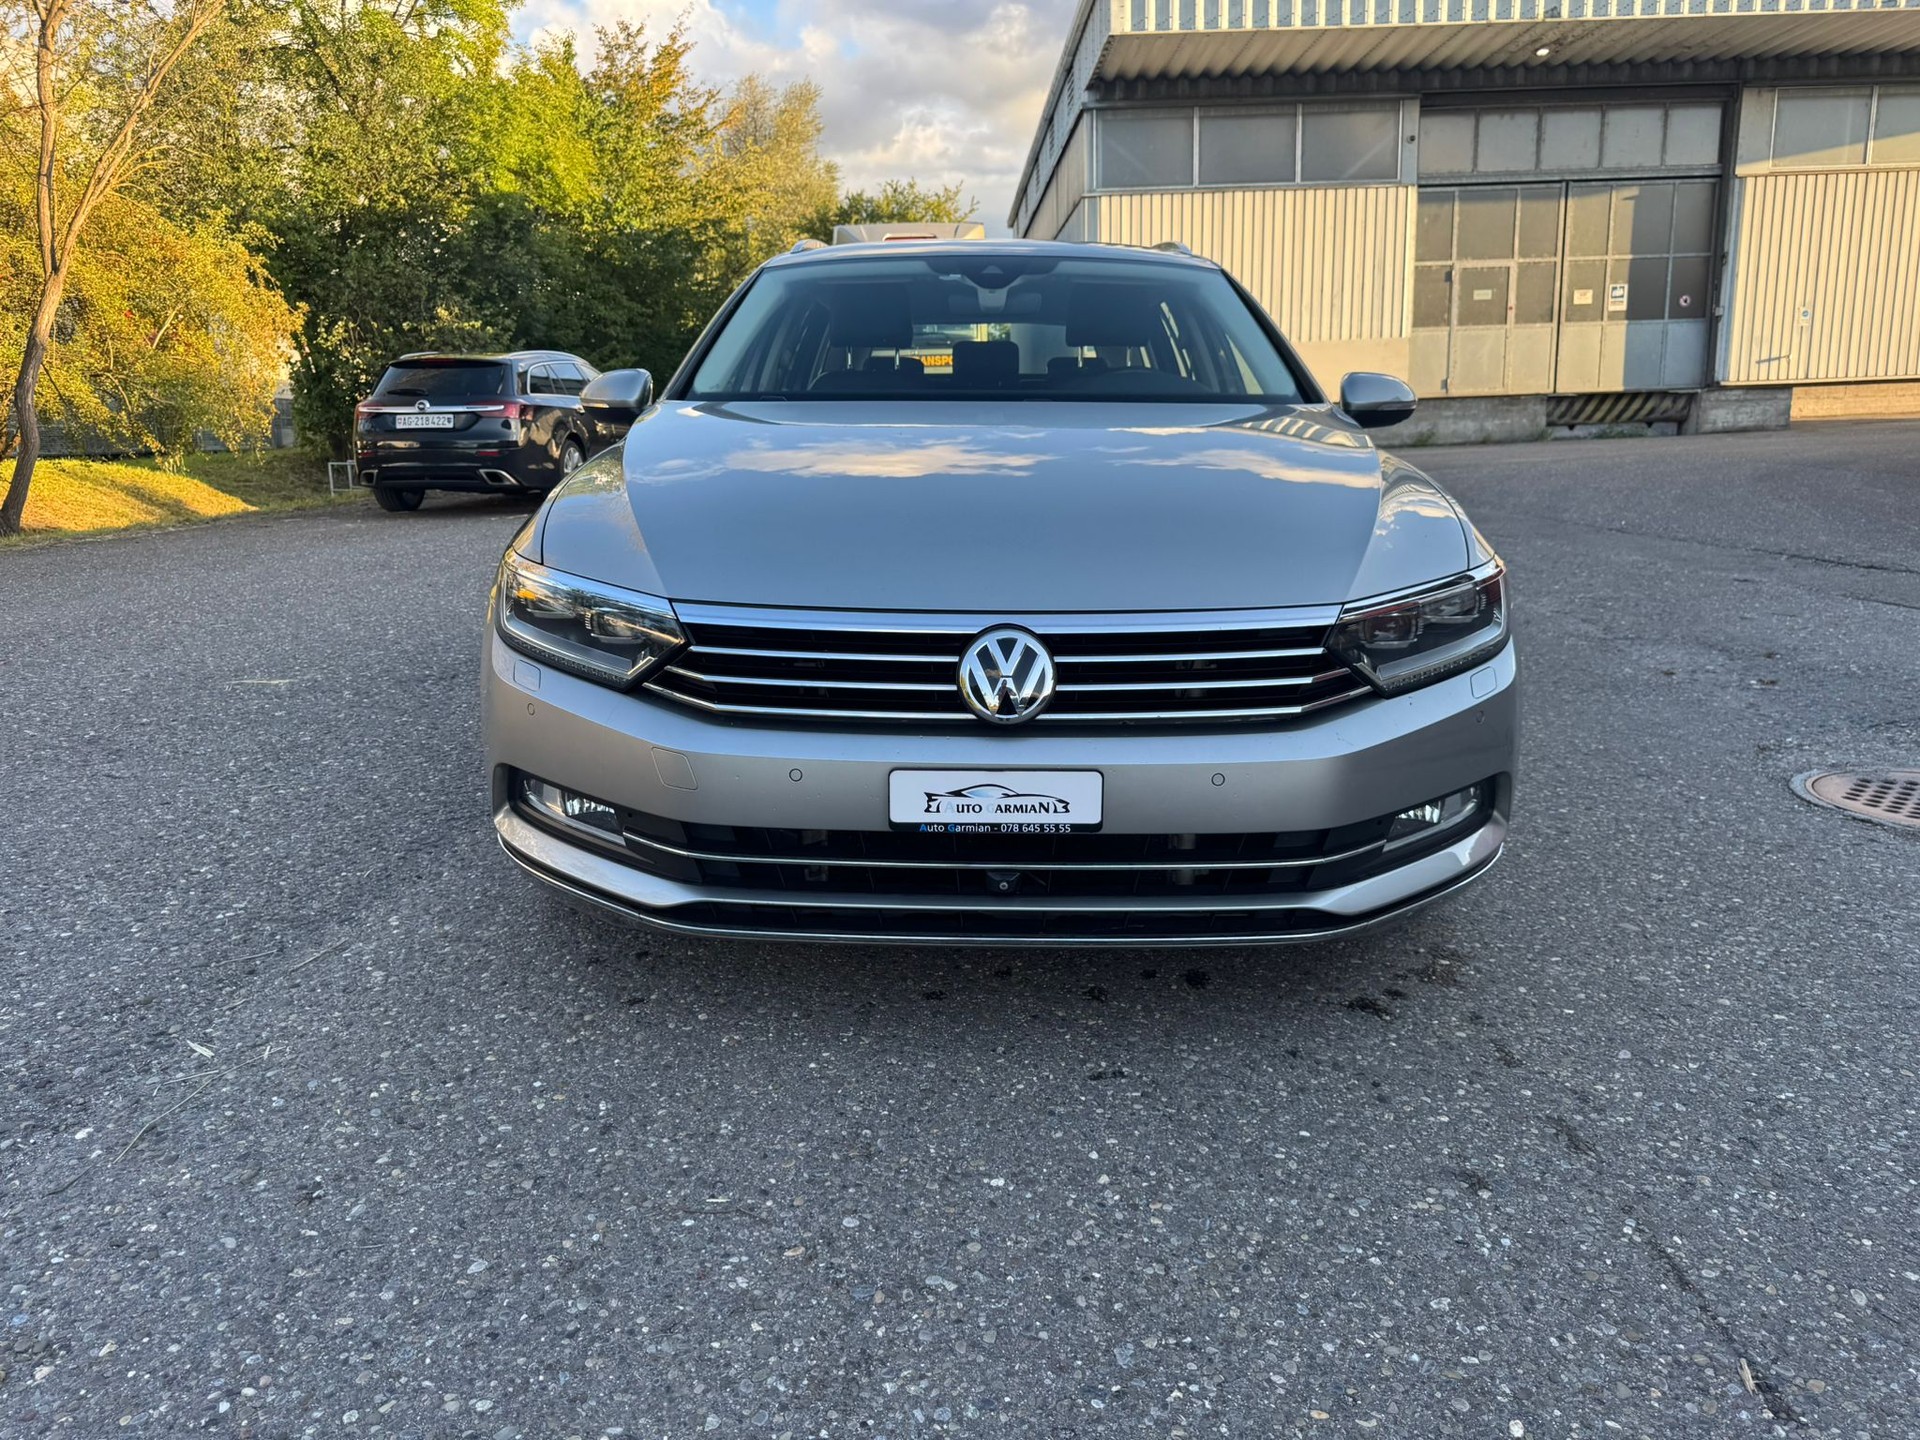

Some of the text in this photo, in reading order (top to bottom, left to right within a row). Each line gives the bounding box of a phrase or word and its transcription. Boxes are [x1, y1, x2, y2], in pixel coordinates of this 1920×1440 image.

[920, 823, 945, 833] Auto
[947, 823, 991, 833] Garmian
[1000, 823, 1019, 833] 078
[1022, 823, 1041, 833] 645
[1043, 823, 1056, 833] 55
[1058, 823, 1071, 833] 55
